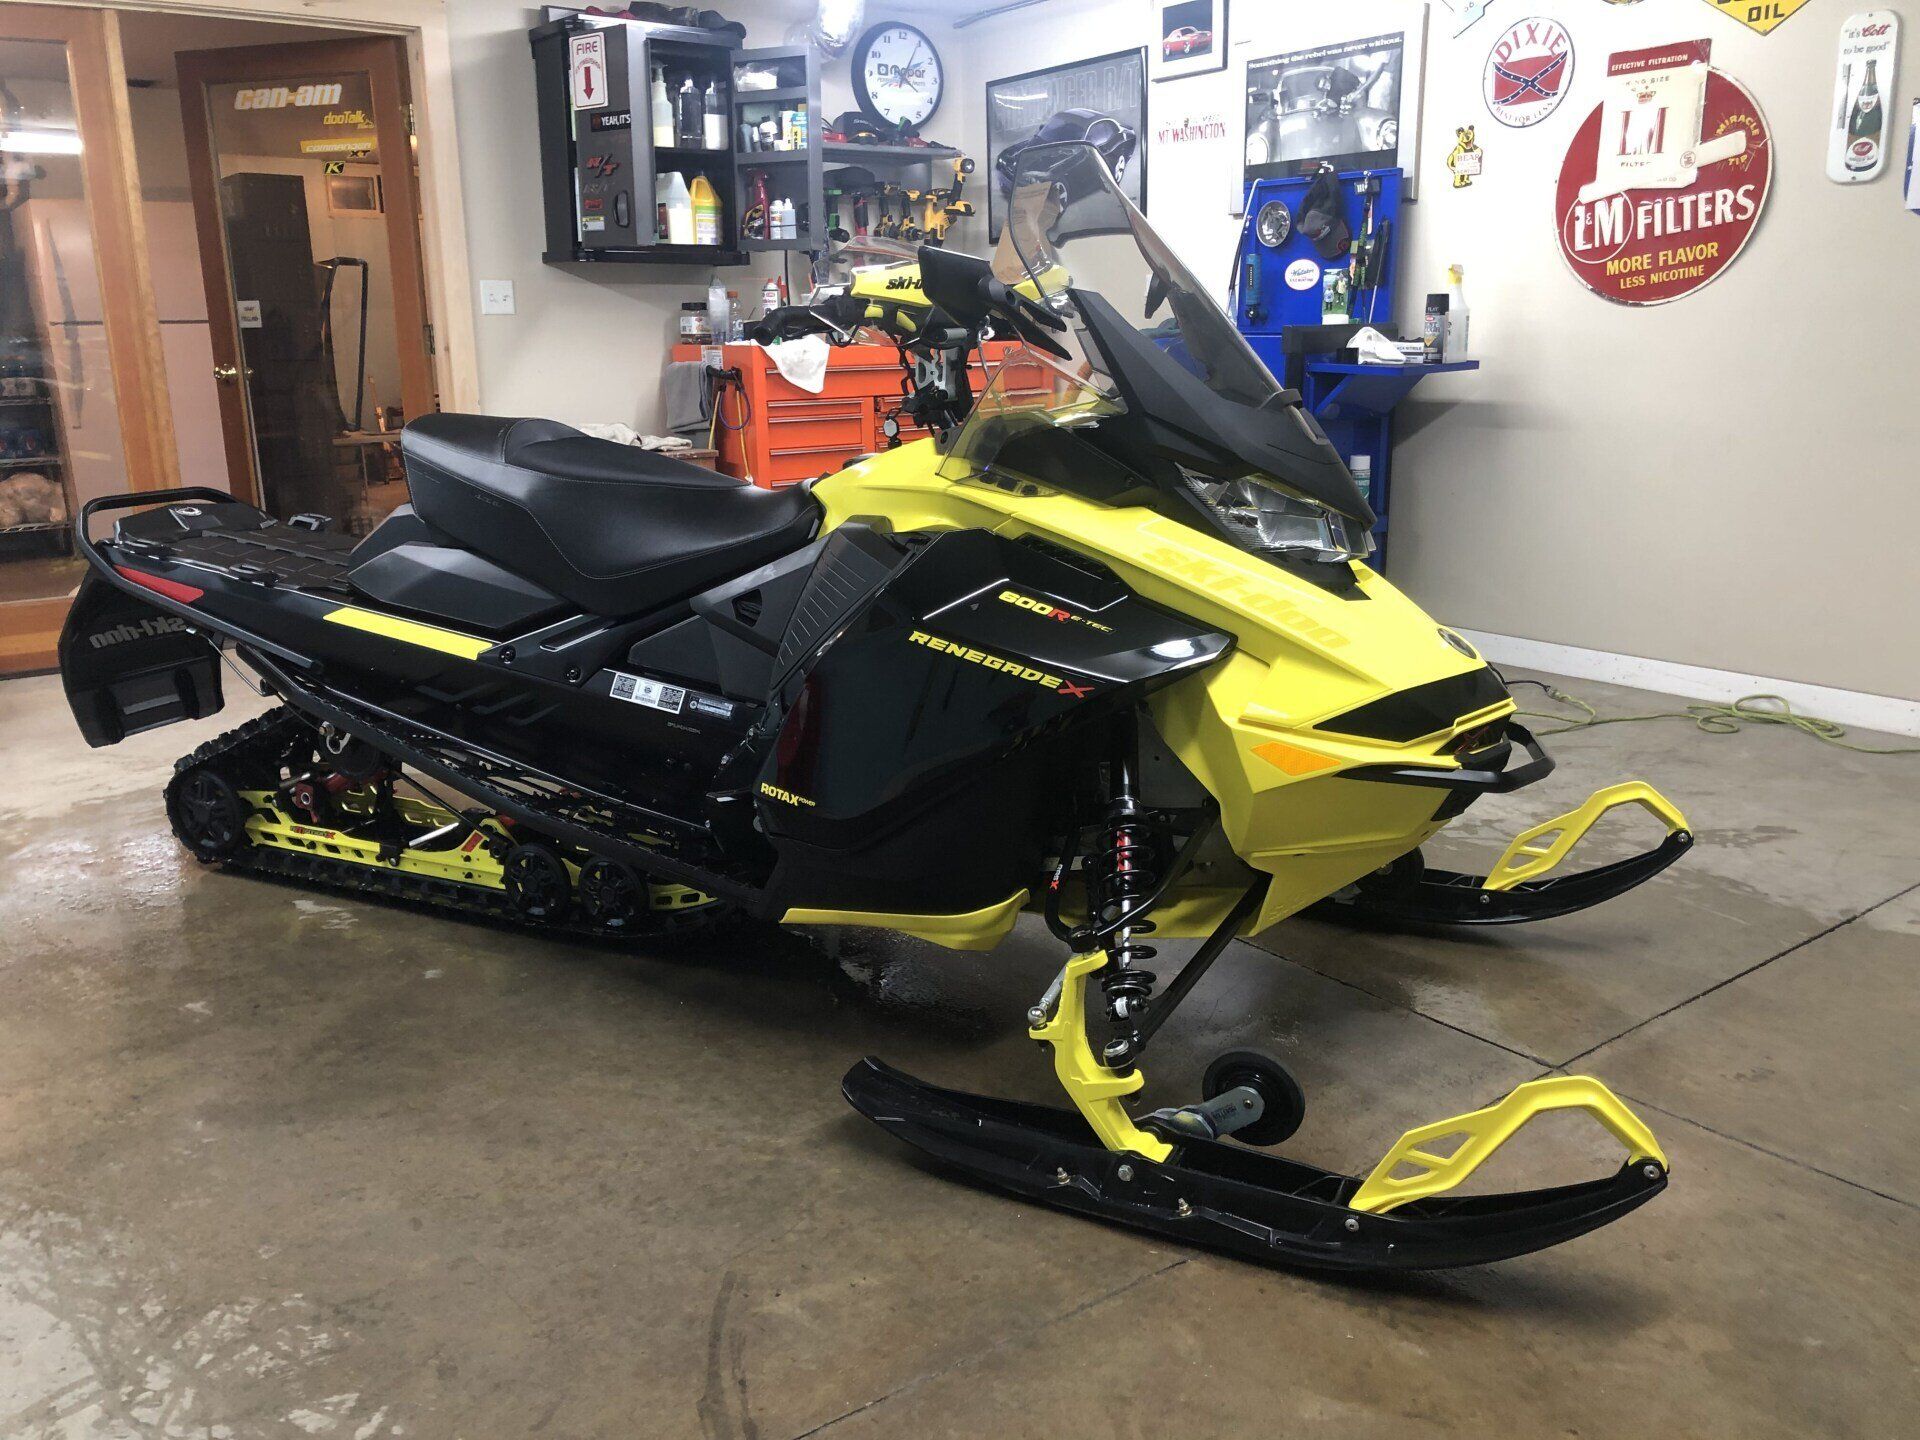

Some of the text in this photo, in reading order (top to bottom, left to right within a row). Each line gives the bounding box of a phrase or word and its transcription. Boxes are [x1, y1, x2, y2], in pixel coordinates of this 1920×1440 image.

[1747, 3, 1785, 23] OIL
[899, 31, 907, 39] 12
[1495, 22, 1567, 66] DIXIE
[576, 41, 598, 55] FIRE
[1248, 57, 1289, 69] Something
[1305, 49, 1326, 60] rebel
[1343, 43, 1367, 52] never
[1611, 54, 1688, 71] EFFECTIVE FILTRATION
[931, 77, 938, 85] 3
[234, 83, 342, 110] can-am
[871, 91, 878, 99] 8
[927, 97, 933, 105] 4
[884, 108, 891, 116] 7
[915, 111, 922, 119] 5
[1715, 114, 1760, 136] MIRACLE
[1728, 154, 1748, 166] TIP
[1636, 184, 1755, 240] FILTERS
[1606, 241, 1719, 276] MORE FLAVOR
[1619, 264, 1705, 289] LESS NICOTINE
[998, 590, 1071, 622] 600R
[908, 630, 1063, 690] RENEGADE
[760, 782, 799, 806] ROTAX
